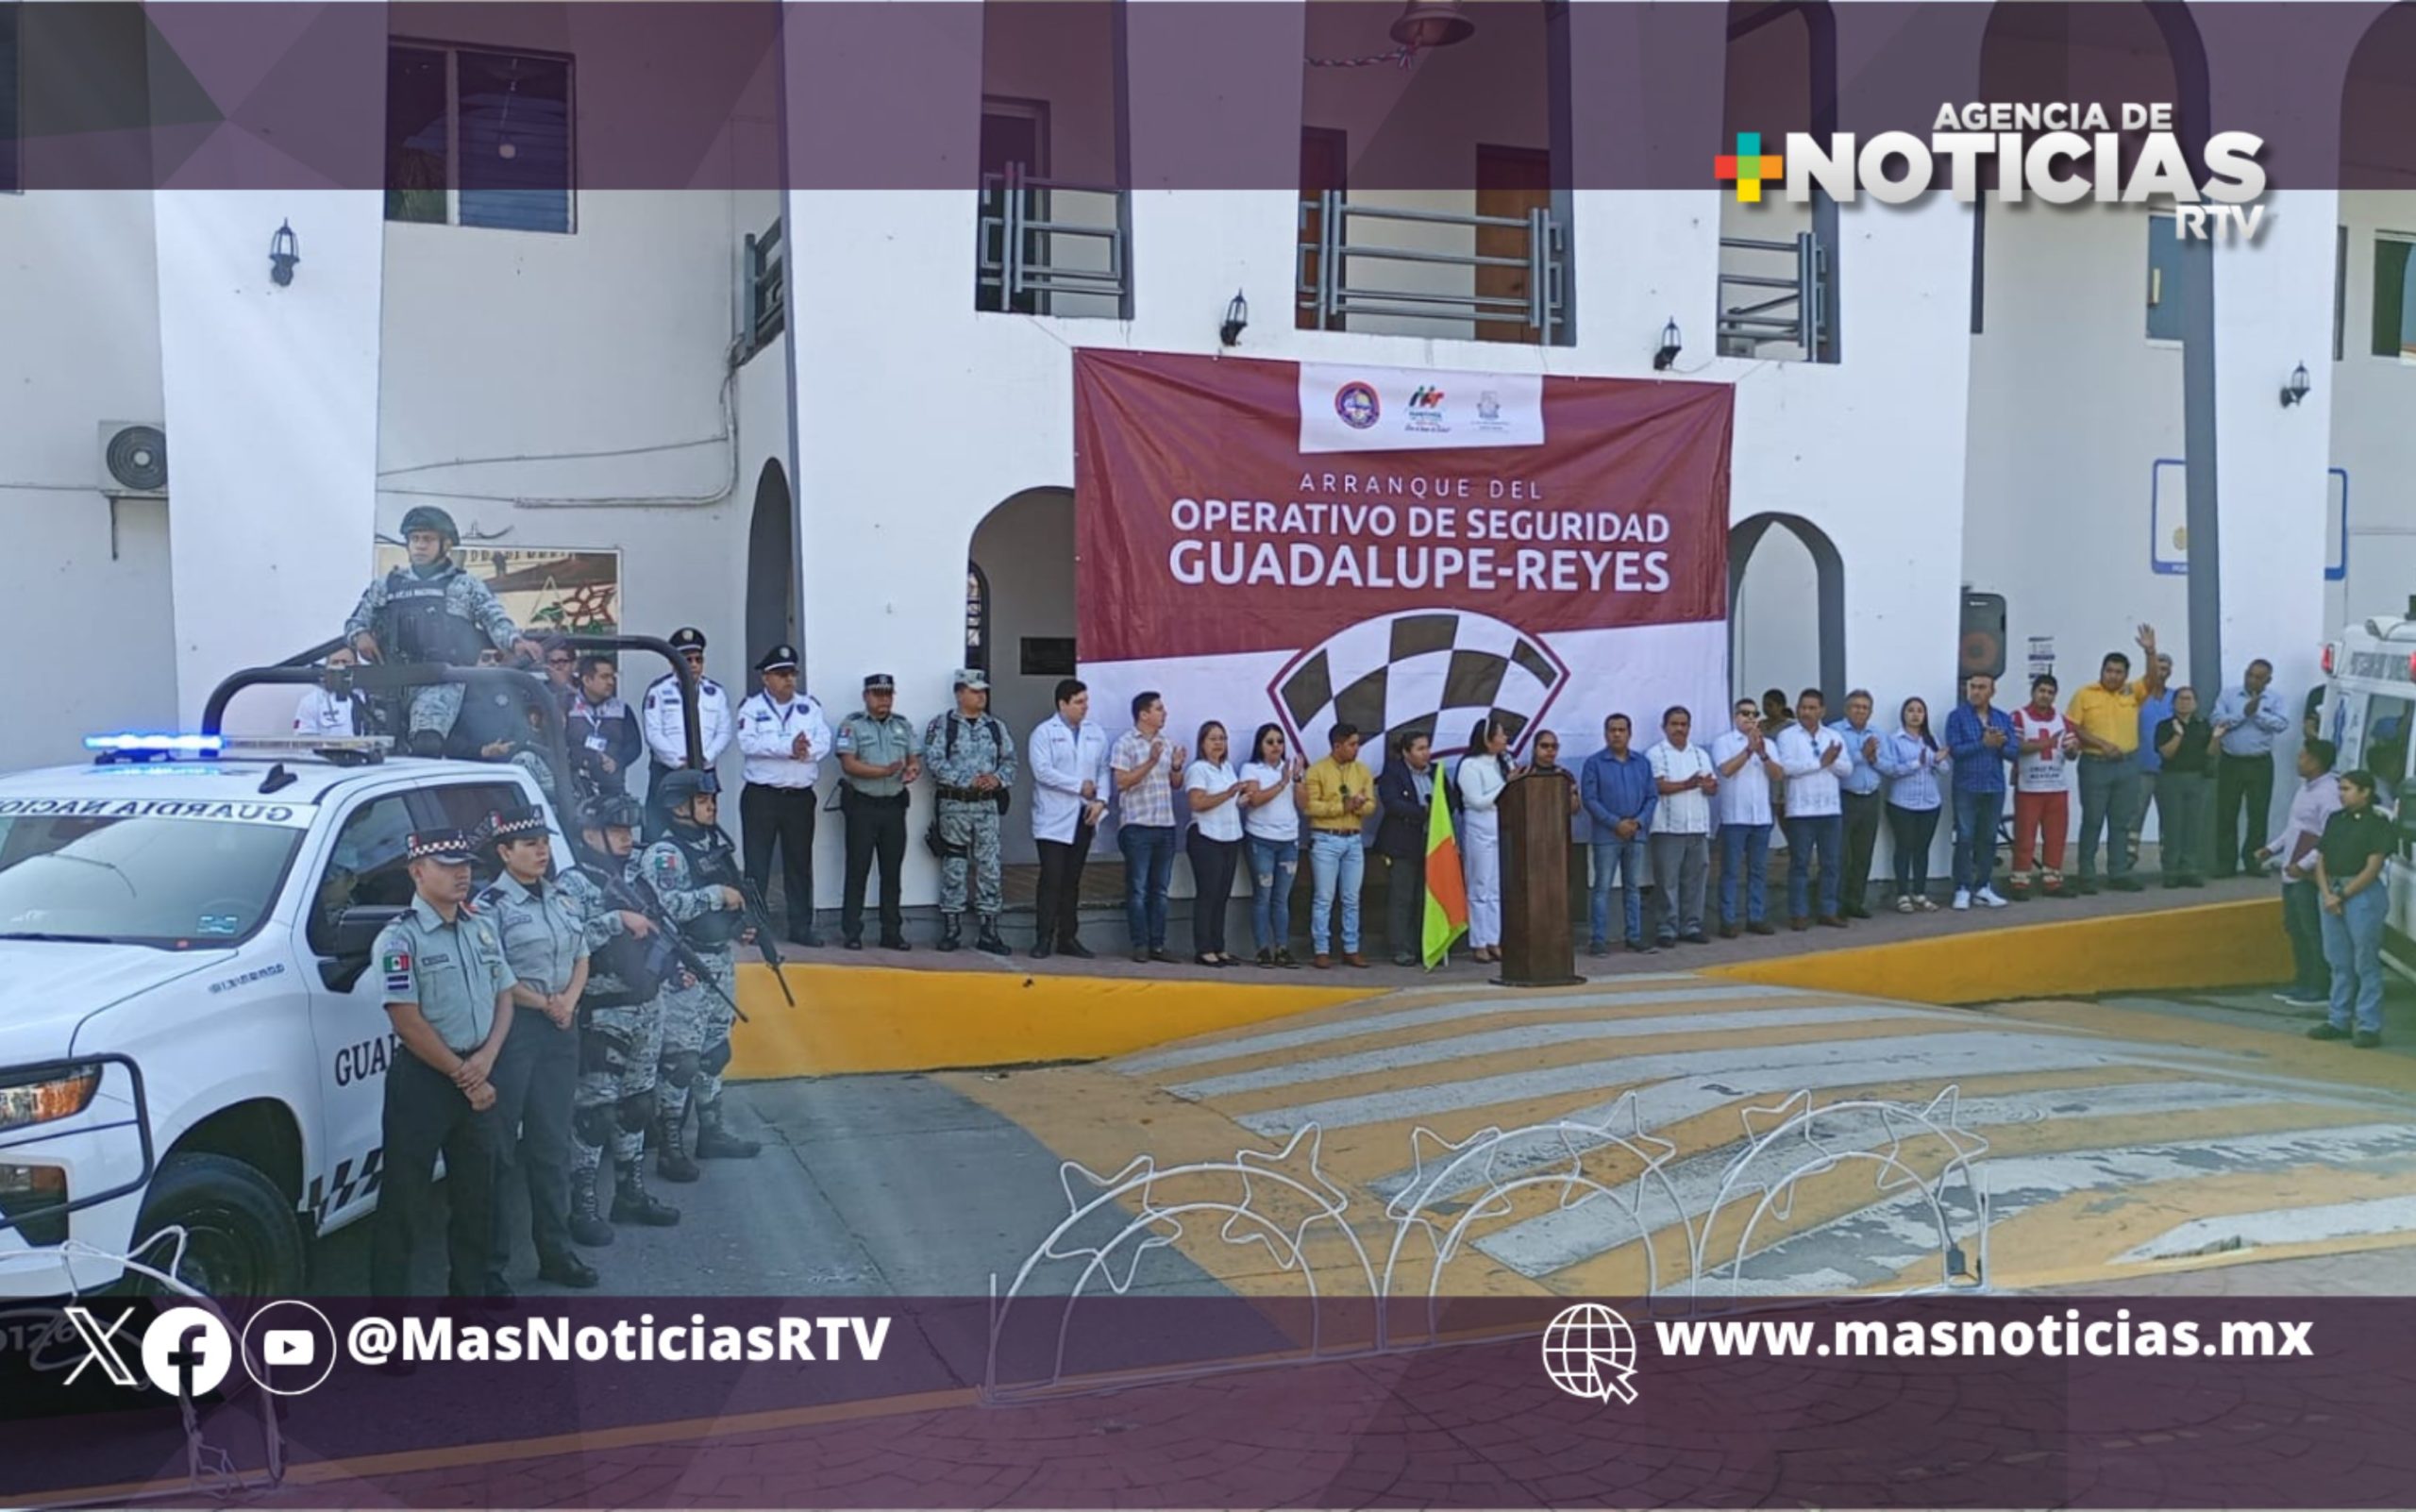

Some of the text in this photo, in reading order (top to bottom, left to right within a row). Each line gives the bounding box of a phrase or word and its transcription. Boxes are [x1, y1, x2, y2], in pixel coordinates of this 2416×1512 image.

[1299, 473, 1542, 500] ARRANQUE DEL
[1171, 498, 1670, 543] OPERATIVO DE SEGURIDAD
[1169, 539, 1671, 593] GUADALUPE-REYES
